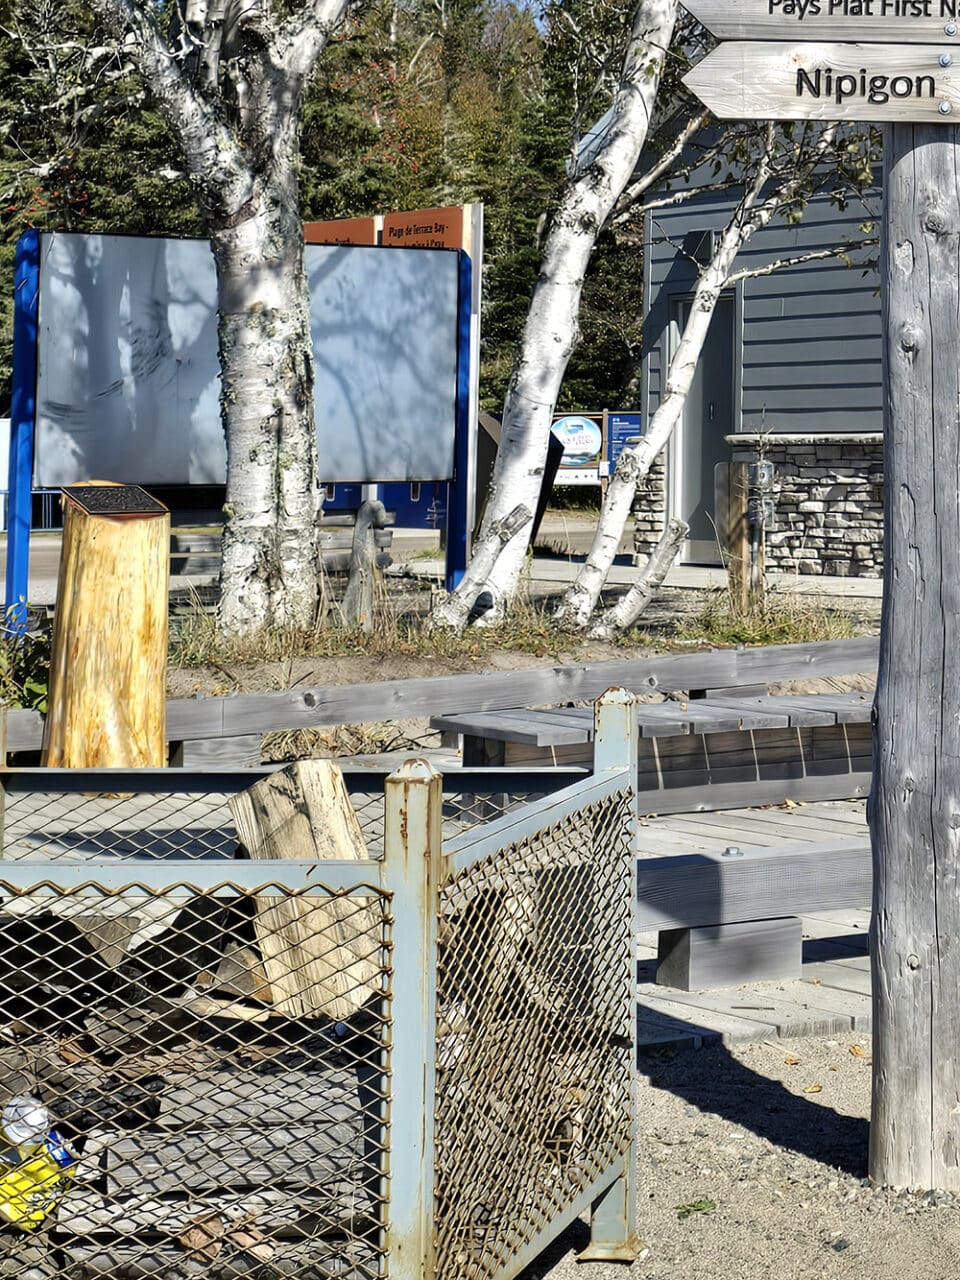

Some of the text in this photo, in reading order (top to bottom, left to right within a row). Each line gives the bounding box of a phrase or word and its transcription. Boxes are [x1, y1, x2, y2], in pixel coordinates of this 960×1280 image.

[795, 68, 936, 105] Nipigon
[388, 226, 404, 239] Plage
[405, 224, 413, 236] de
[413, 224, 433, 235] Terrace
[434, 222, 445, 234] Bay
